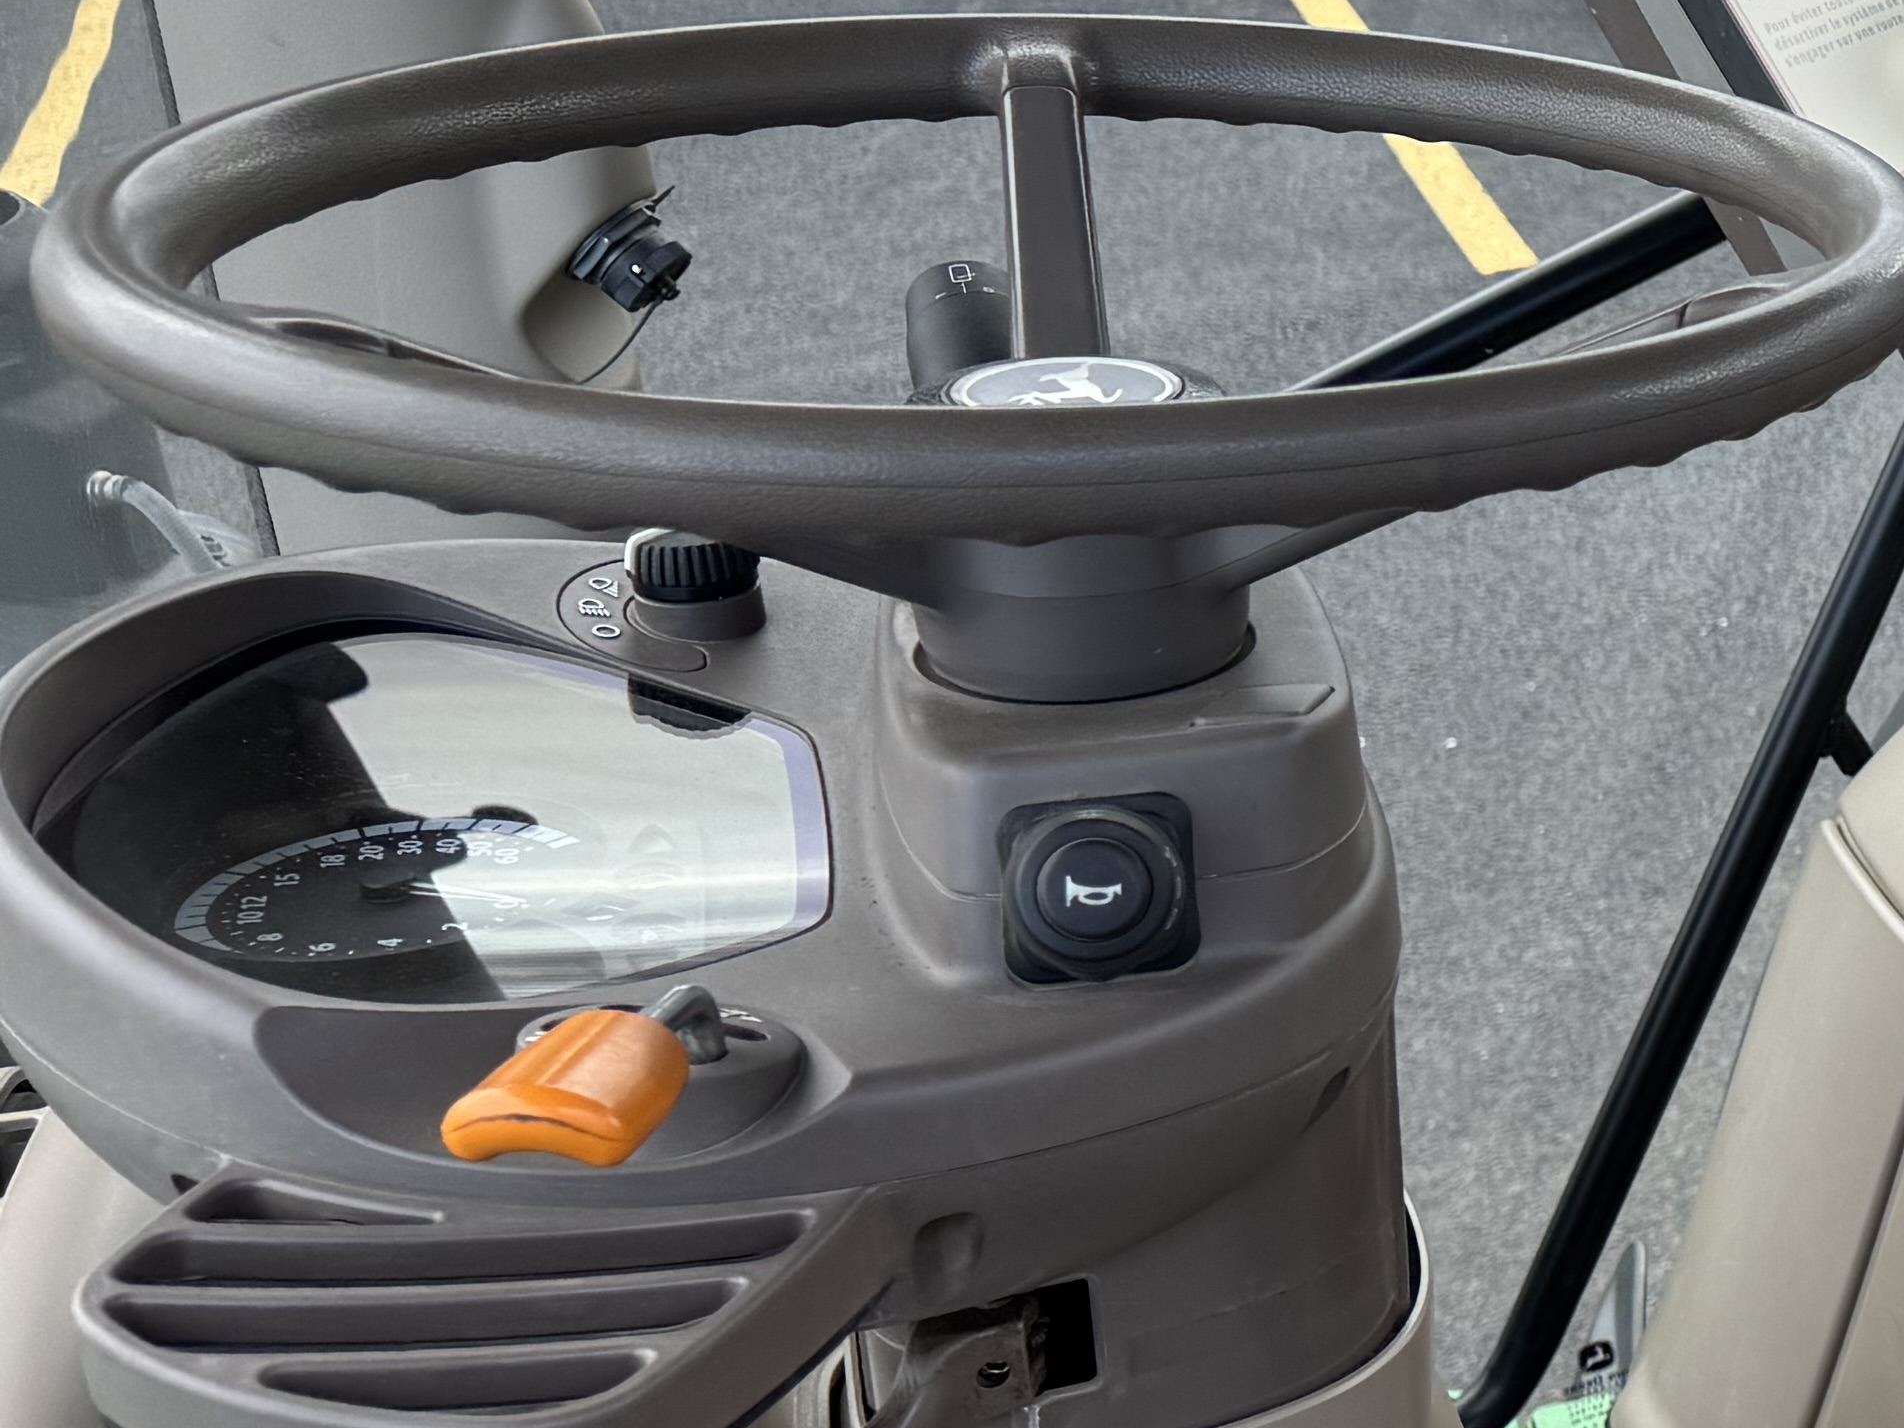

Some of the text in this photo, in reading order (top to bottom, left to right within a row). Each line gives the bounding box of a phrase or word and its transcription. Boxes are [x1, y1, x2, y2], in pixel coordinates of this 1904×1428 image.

[358, 845, 384, 861] 20
[397, 840, 423, 856] 30
[436, 838, 462, 854] 40
[467, 840, 493, 857] 50
[319, 854, 346, 869] 18
[493, 848, 520, 865] 60
[273, 873, 300, 887] 15
[240, 895, 268, 910] 12
[236, 911, 264, 925] 10
[256, 932, 283, 942] 8
[377, 938, 403, 947] 4
[308, 942, 336, 953] 6
